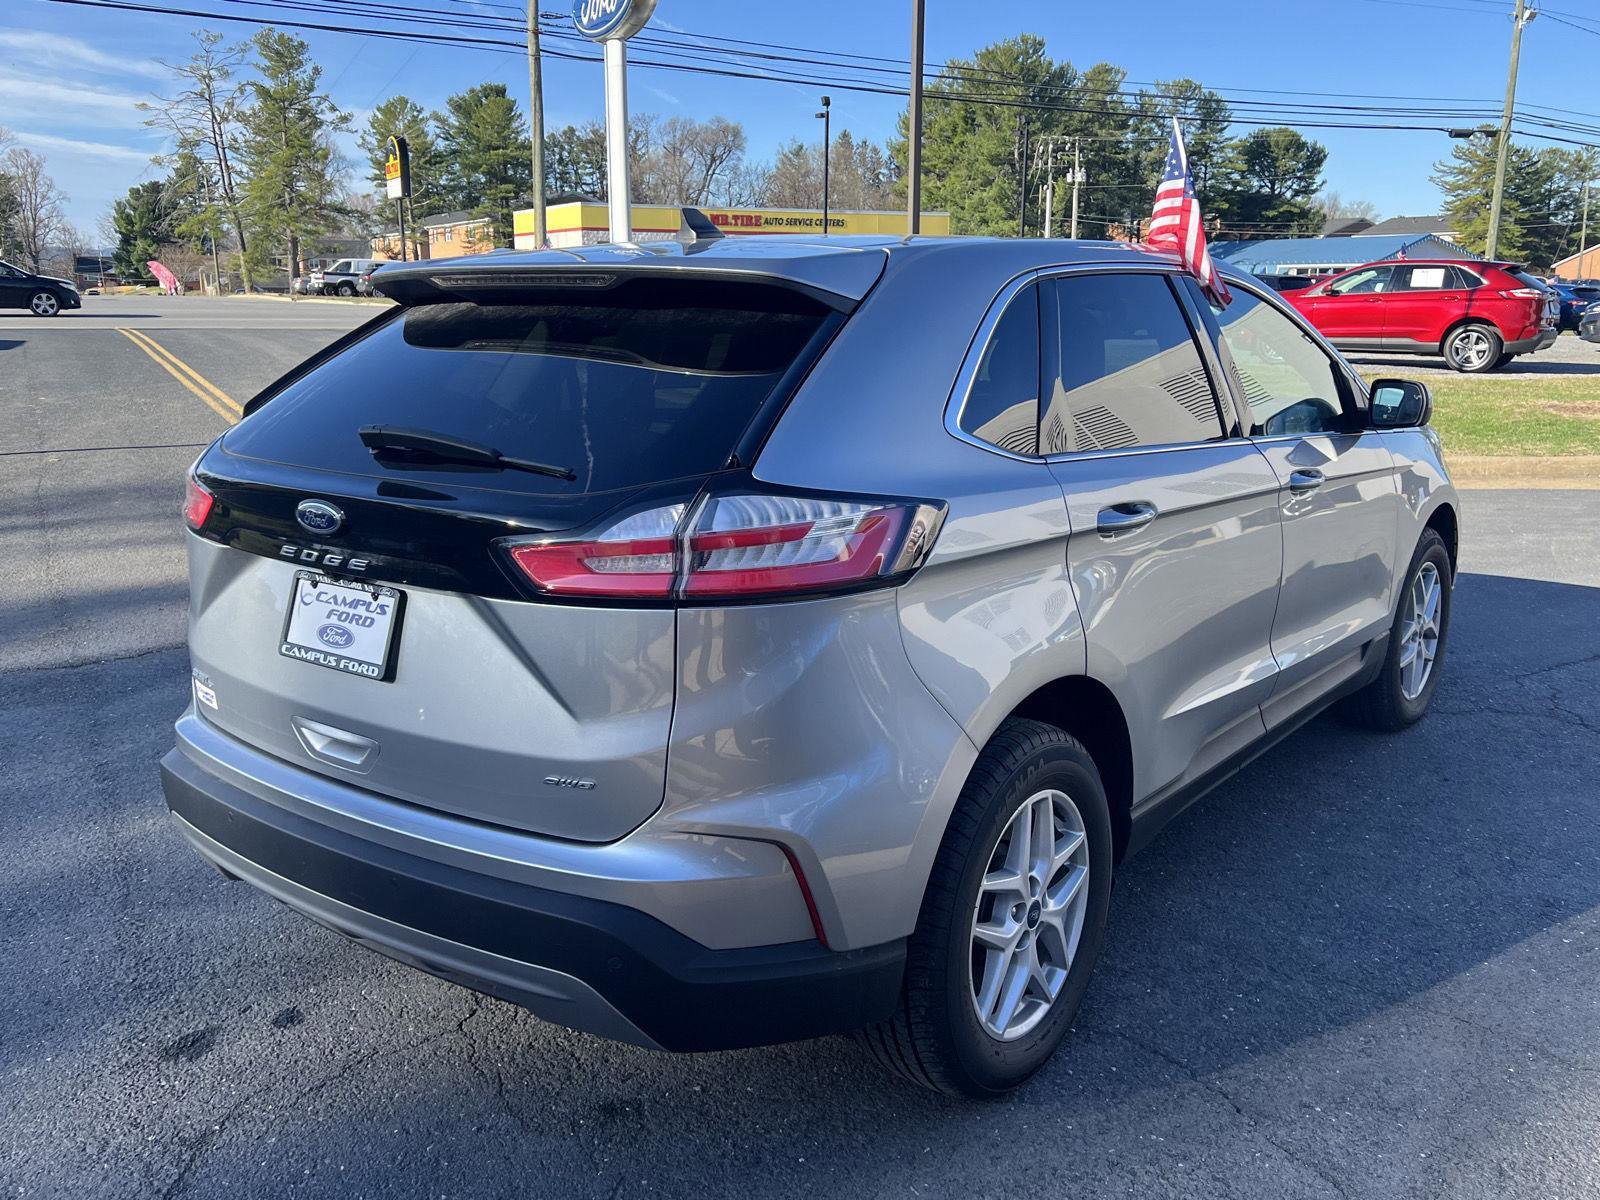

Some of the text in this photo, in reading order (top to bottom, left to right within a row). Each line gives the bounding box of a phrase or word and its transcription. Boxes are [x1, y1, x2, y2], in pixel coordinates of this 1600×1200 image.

[763, 216, 784, 226] AUTO
[785, 217, 814, 227] SERVICE
[814, 218, 846, 228] CETERS
[303, 508, 329, 528] Ford
[280, 545, 371, 571] EDGE
[315, 591, 390, 616] CAMPUS
[326, 608, 376, 629] FORD
[322, 627, 349, 645] Ford
[281, 644, 379, 677] CAMPUS FORD
